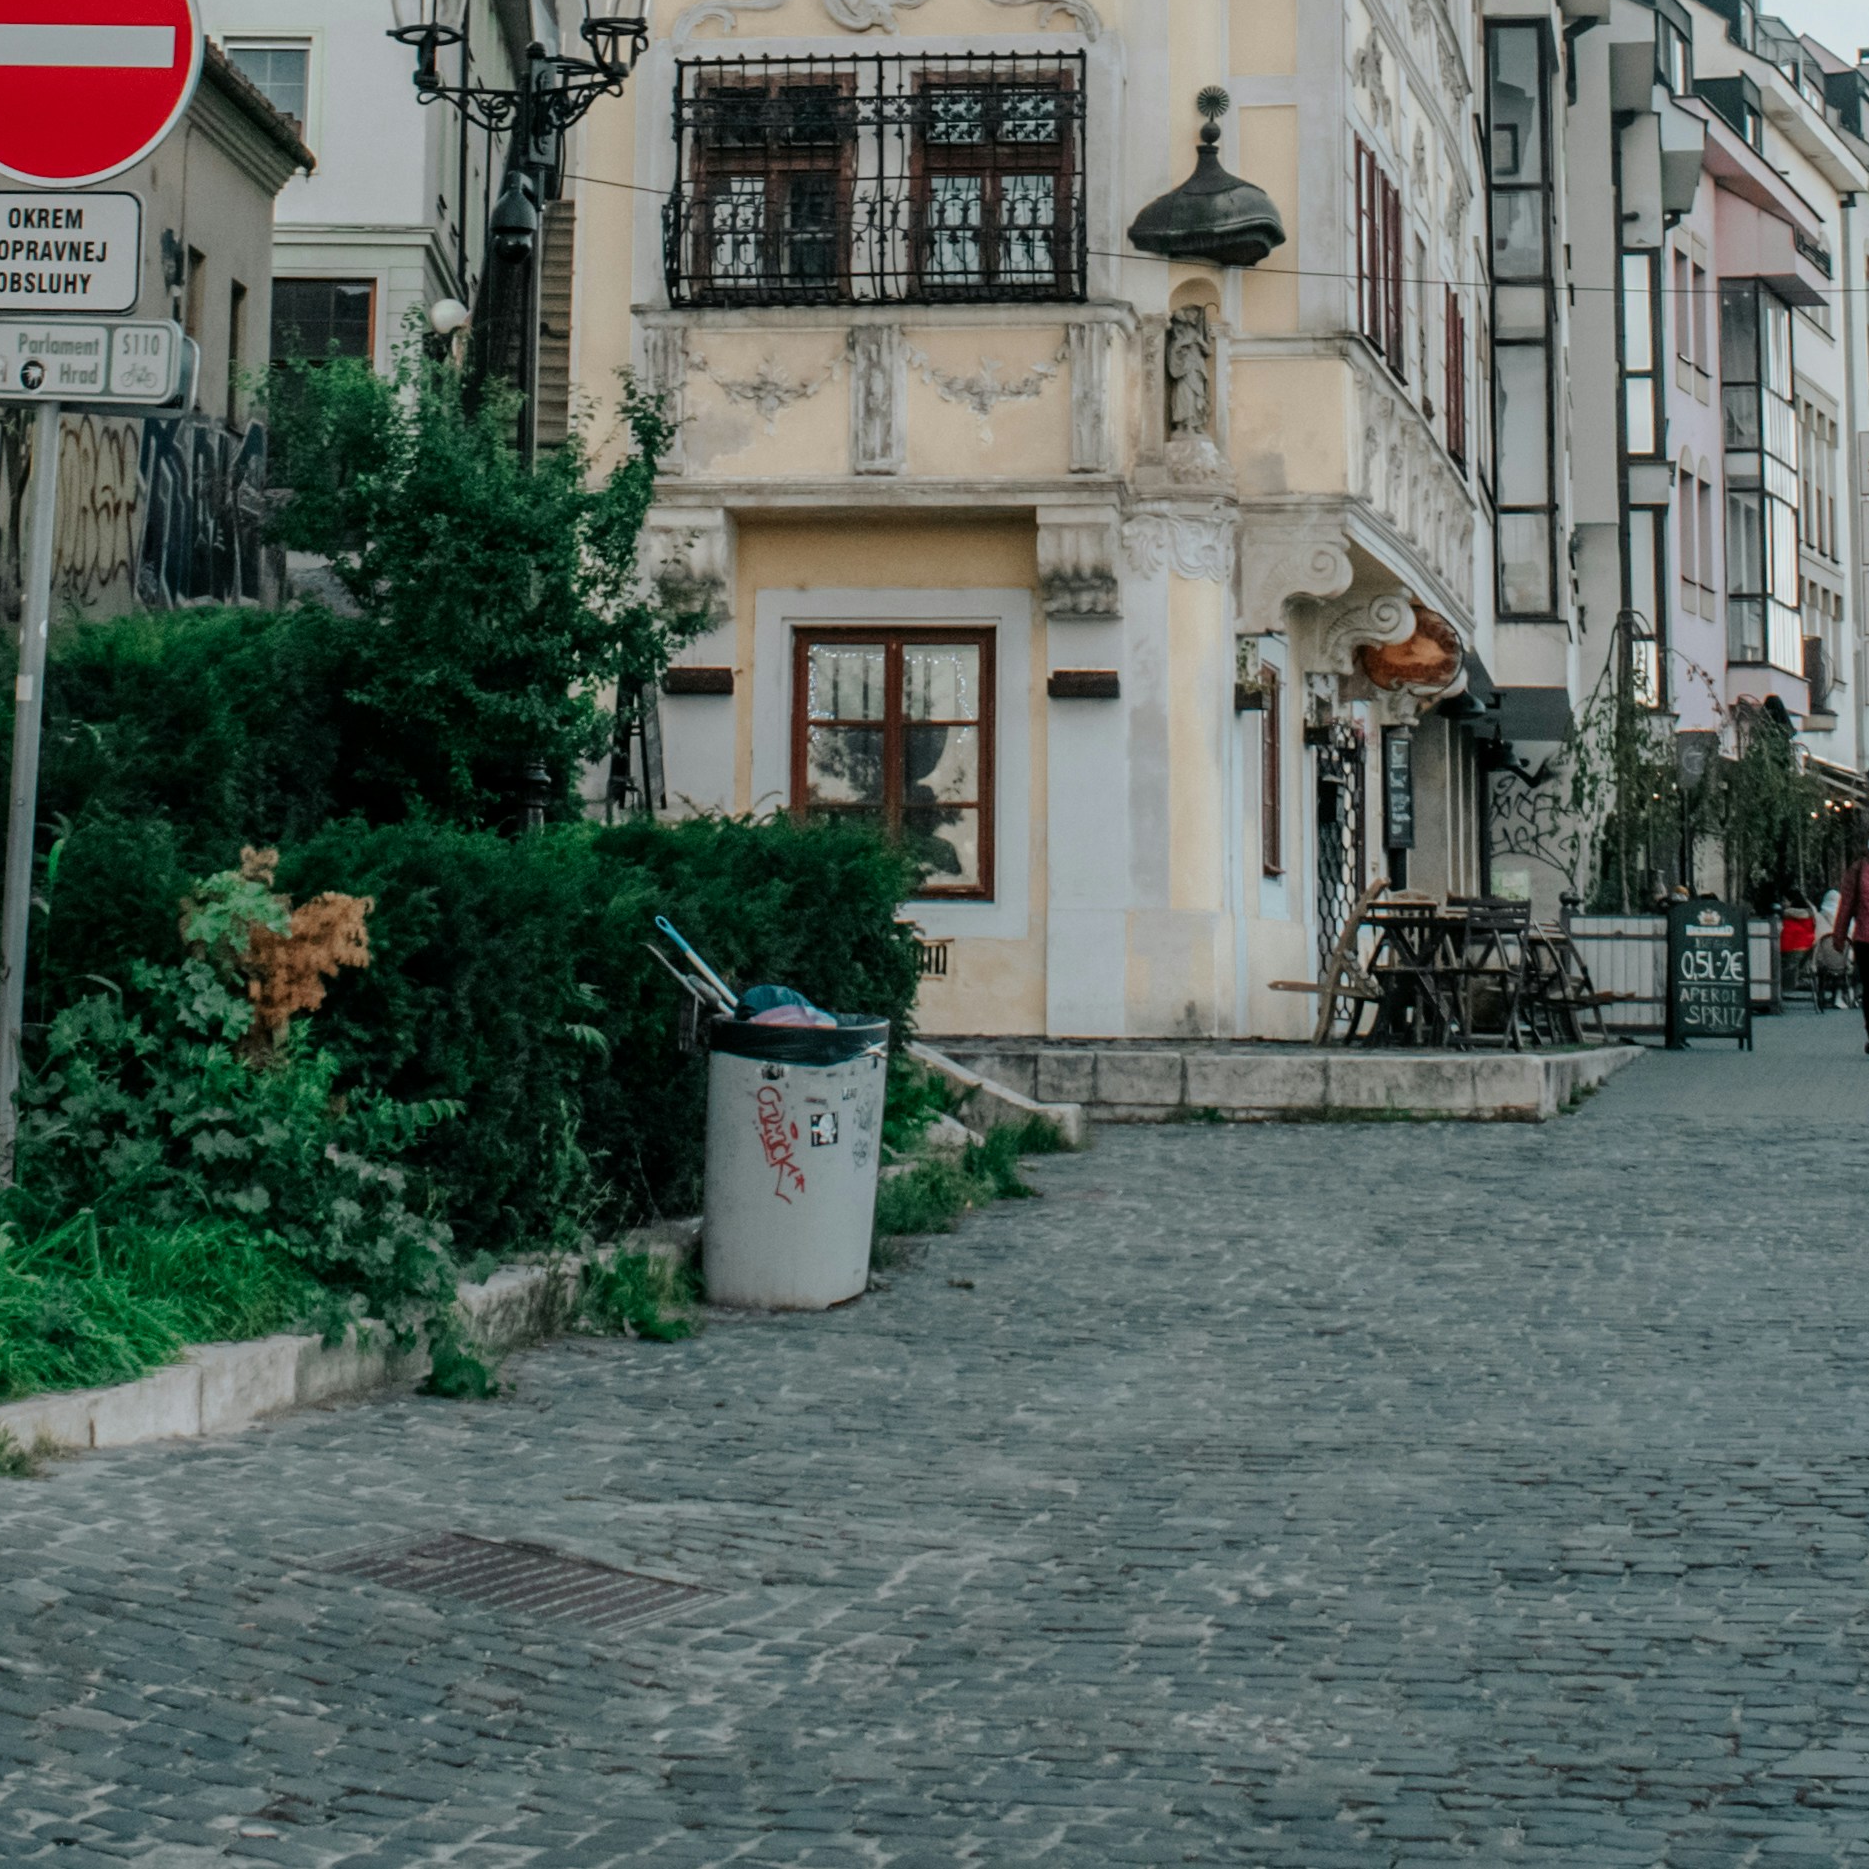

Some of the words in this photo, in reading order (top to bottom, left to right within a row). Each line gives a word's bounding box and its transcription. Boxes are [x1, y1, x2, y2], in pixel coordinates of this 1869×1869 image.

[8, 207, 84, 229] OKREM
[18, 331, 99, 356] Parlament
[123, 334, 160, 356] S110
[60, 362, 98, 384] Hrad
